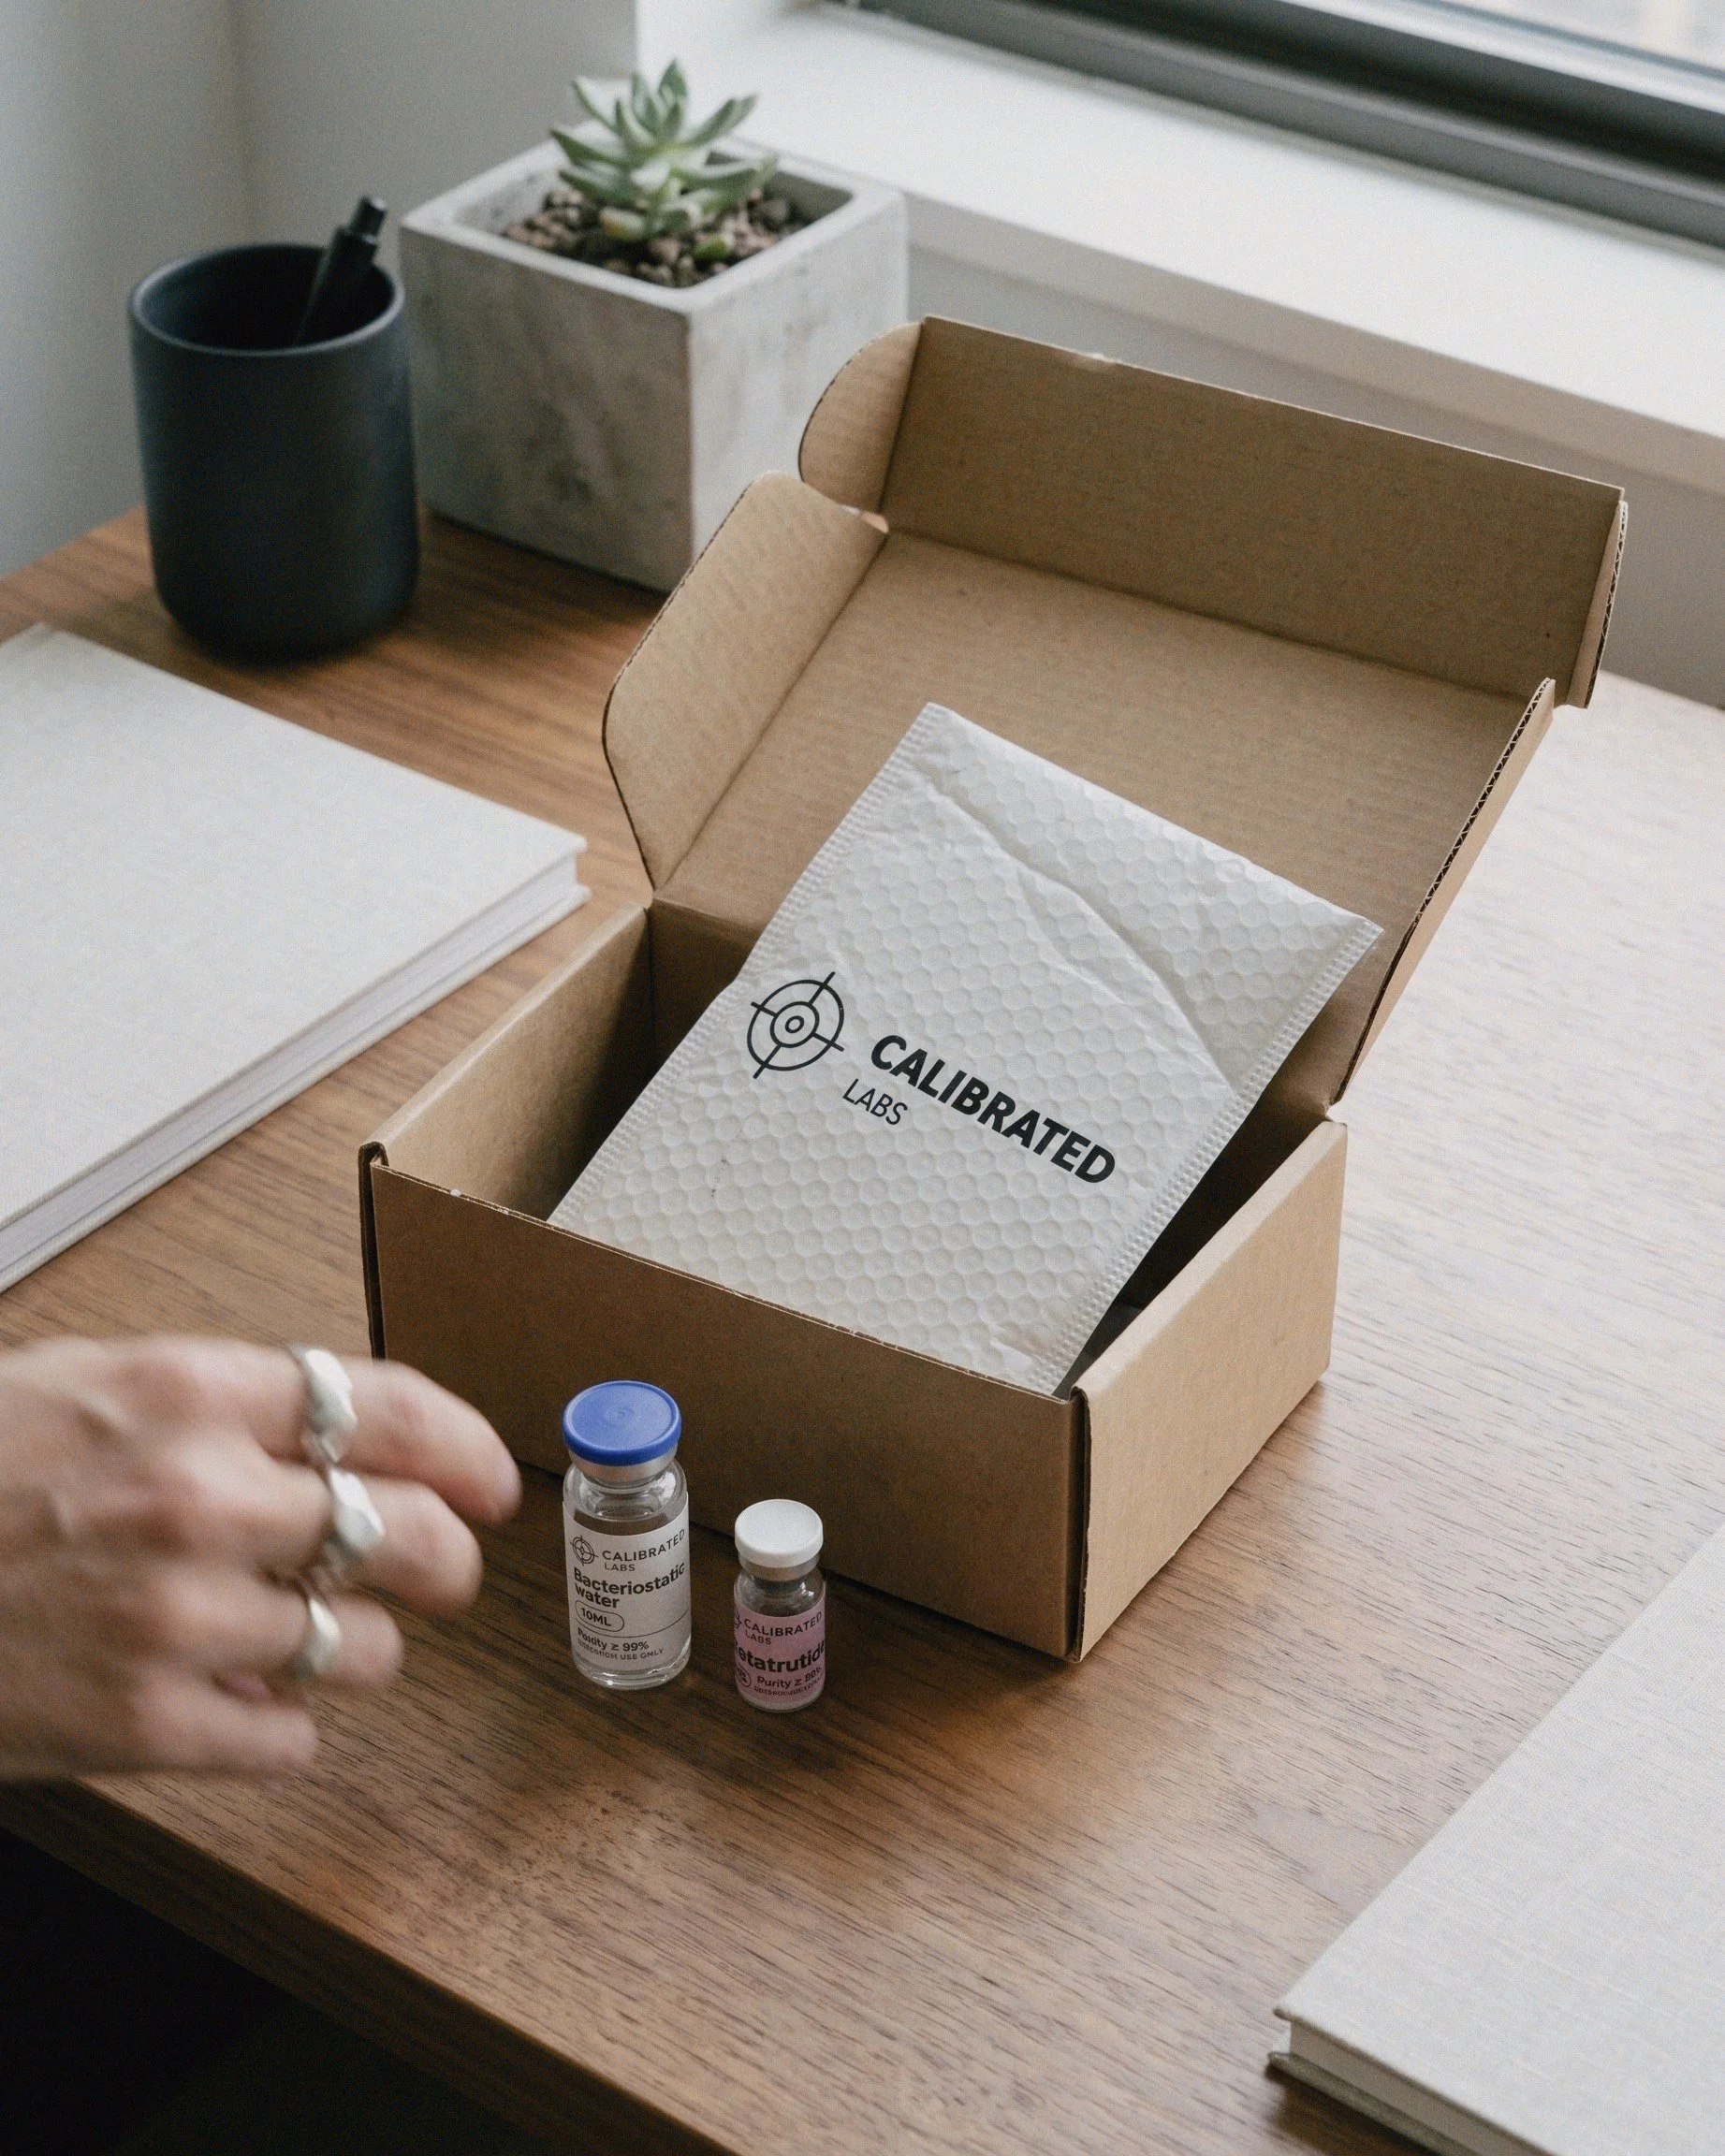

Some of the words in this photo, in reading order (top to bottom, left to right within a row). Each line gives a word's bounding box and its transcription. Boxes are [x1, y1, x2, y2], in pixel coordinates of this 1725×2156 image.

[842, 1078, 908, 1126] LABS
[870, 1034, 1116, 1184] CALIBRATED
[602, 1528, 685, 1562] CALIBRATED
[573, 1562, 685, 1595] Bacteriostatic
[604, 1563, 636, 1572] LABS
[581, 1608, 612, 1626] 10ML
[744, 1611, 822, 1637] CALIBRATED
[622, 1640, 650, 1652] 99%
[745, 1629, 772, 1645] LABS
[735, 1639, 825, 1673] etatrutid
[756, 1675, 792, 1689] Purity
